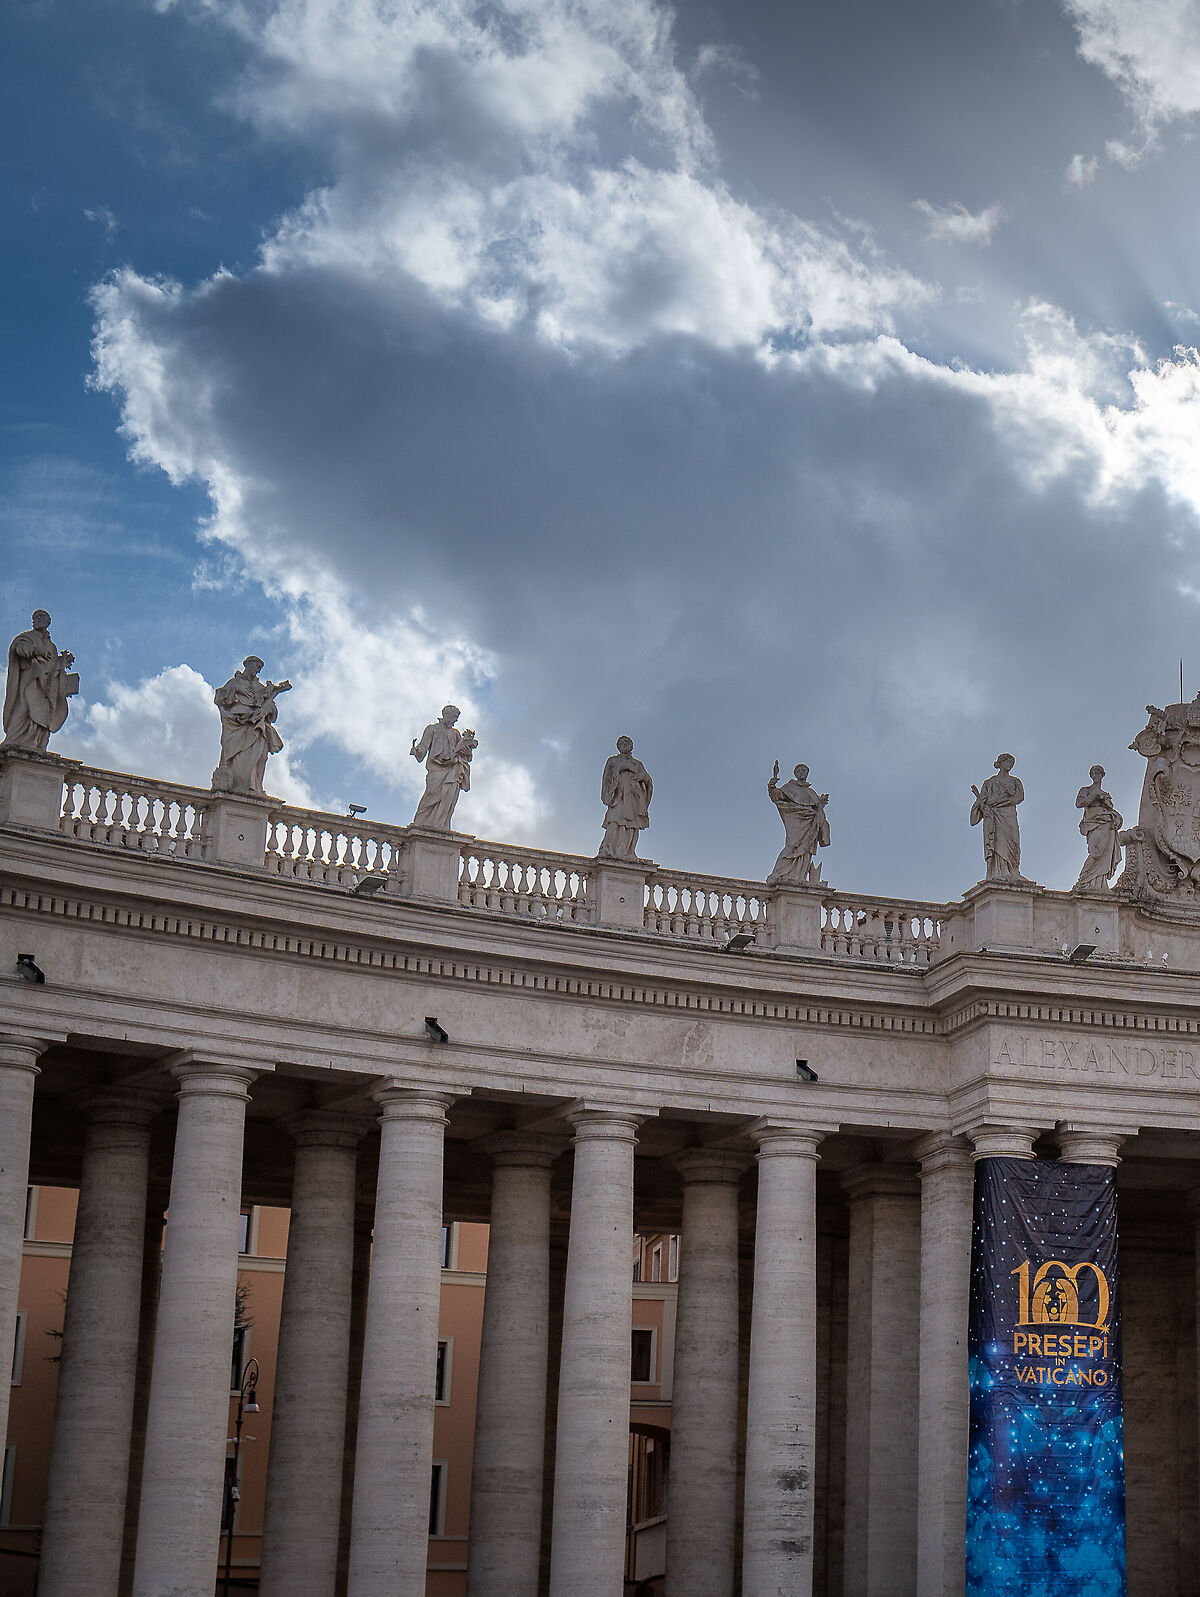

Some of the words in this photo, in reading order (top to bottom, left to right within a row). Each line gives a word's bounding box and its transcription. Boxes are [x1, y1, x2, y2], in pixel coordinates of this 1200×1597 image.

[1010, 1259, 1110, 1328] 100
[1013, 1332, 1109, 1358] PRESEPI
[1055, 1357, 1066, 1367] IN
[1014, 1365, 1108, 1387] VATICANO
